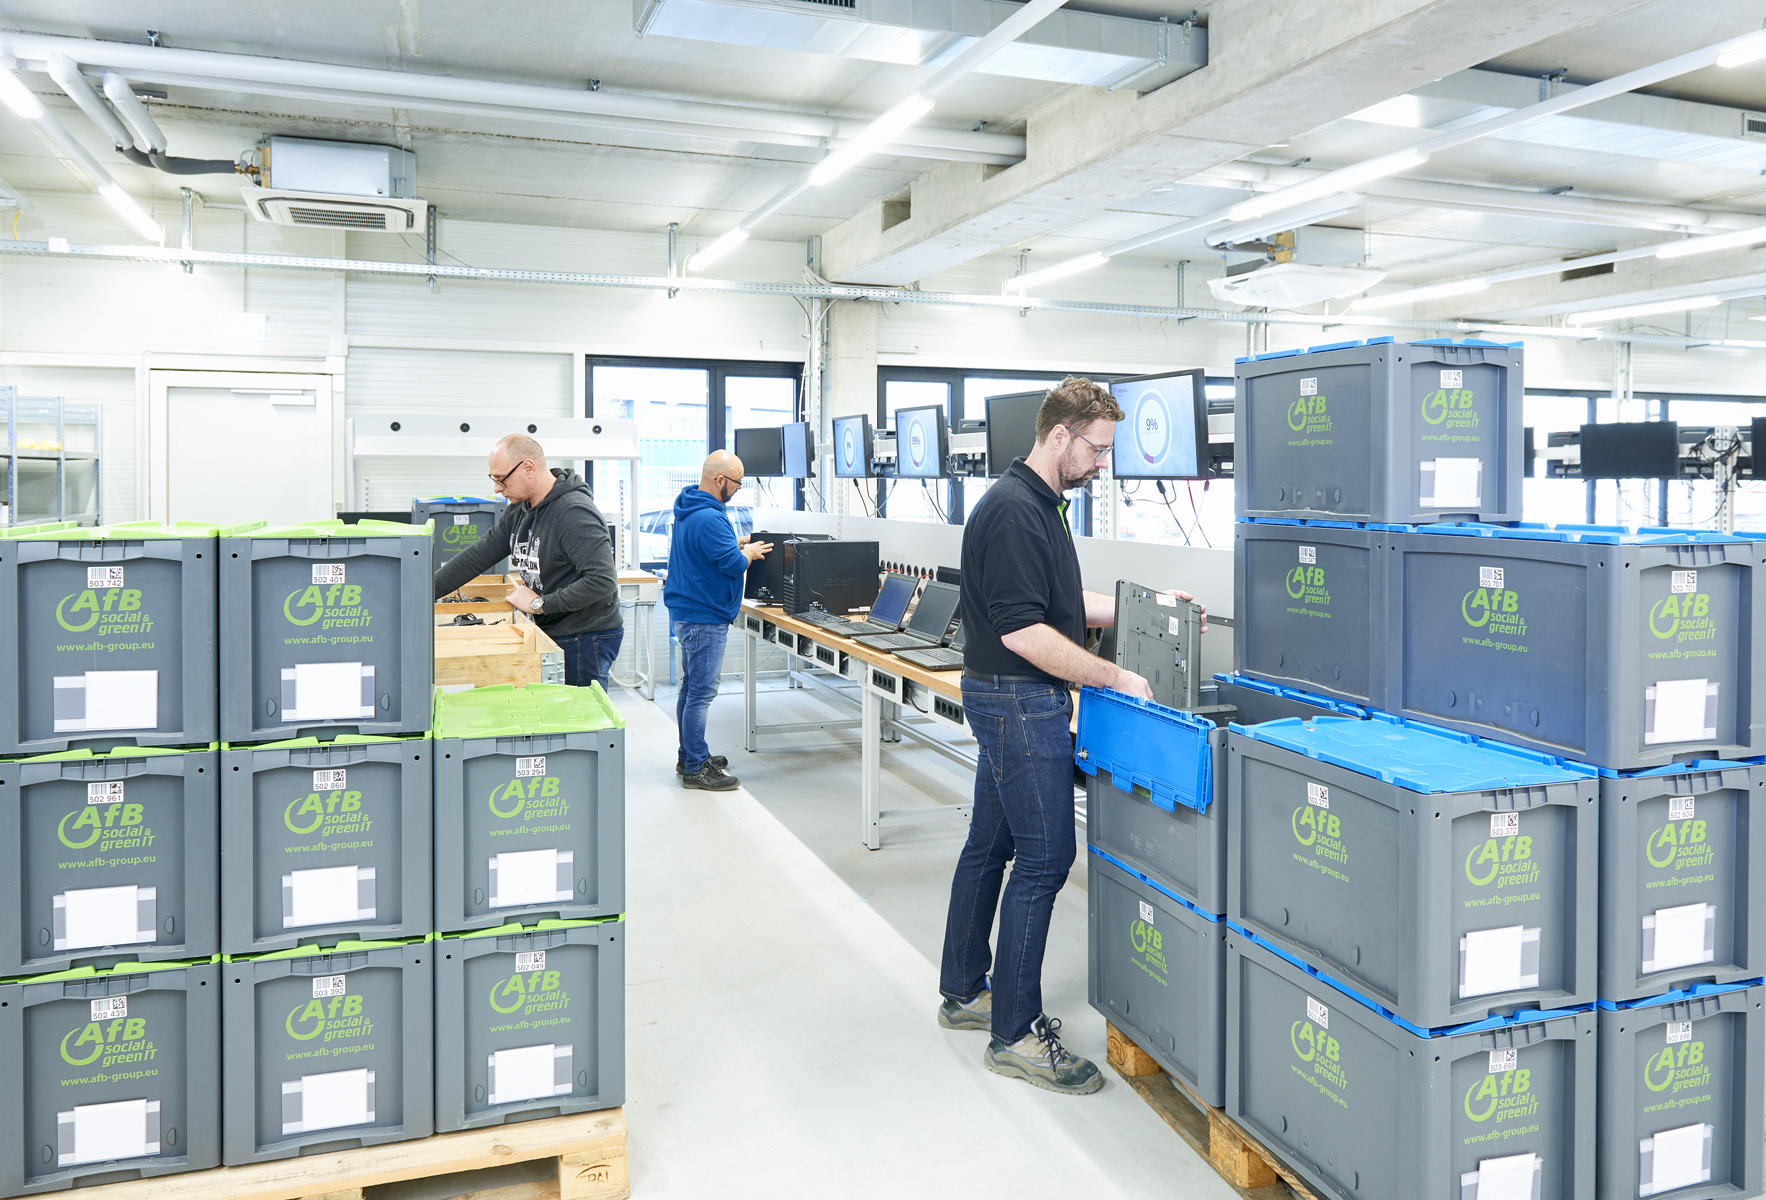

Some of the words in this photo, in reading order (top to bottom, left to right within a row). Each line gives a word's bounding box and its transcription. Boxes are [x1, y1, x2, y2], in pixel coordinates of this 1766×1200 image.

[1294, 396, 1326, 415] AfB
[1430, 389, 1473, 408] AfB
[1448, 409, 1473, 418] social
[1146, 418, 1158, 430] 9%
[1421, 434, 1479, 443] www.afb-group.eu
[448, 524, 477, 534] AfB
[1292, 566, 1324, 585] AfB
[70, 588, 142, 612] AfB
[296, 584, 362, 606] AfB
[1471, 588, 1518, 612] AfB
[324, 607, 361, 617] social
[1659, 593, 1709, 618] AfB
[101, 612, 141, 622] social
[1490, 613, 1519, 624] social
[1680, 617, 1708, 629] social
[57, 642, 154, 652] www.afb-group.eu
[284, 635, 373, 645] www.afb-group.eu
[1462, 637, 1527, 652] www.afb-group.eu
[1649, 649, 1716, 659] www.afb-group.eu
[500, 777, 560, 800] AfB
[297, 791, 361, 815] AfB
[526, 797, 560, 808] social
[71, 803, 143, 829] AfB
[325, 812, 362, 824] social
[1299, 806, 1340, 838] AfB
[102, 826, 143, 838] social
[490, 824, 570, 836] www.afb-group.eu
[1656, 820, 1706, 847] AfB
[285, 841, 373, 853] www.afb-group.eu
[1317, 834, 1341, 850] social
[1677, 843, 1706, 856] social
[1476, 836, 1532, 864] AfB
[58, 856, 156, 868] www.afb-group.eu
[1293, 853, 1349, 882] www.afb-group.eu
[1500, 860, 1531, 874] social
[1646, 874, 1714, 888] www.afb-group.eu
[1465, 893, 1540, 907] www.afb-group.eu
[1136, 920, 1162, 949] AfB
[501, 970, 560, 996] AfB
[526, 990, 560, 1003] social
[298, 995, 363, 1022] AfB
[326, 1016, 363, 1029] social
[490, 1017, 570, 1032] www.afb-group.eu
[74, 1018, 146, 1046] AfB
[105, 1040, 145, 1054] social
[1299, 1021, 1339, 1061] AfB
[287, 1044, 374, 1060] www.afb-group.eu
[1654, 1042, 1704, 1071] AfB
[61, 1069, 158, 1086] www.afb-group.eu
[1675, 1064, 1703, 1079] social
[1291, 1064, 1347, 1108] www.afb-group.eu
[1475, 1069, 1530, 1101] AfB
[1498, 1093, 1530, 1108] social
[1644, 1094, 1711, 1113] www.afb-group.eu
[1464, 1125, 1539, 1144] www.afb-group.eu
